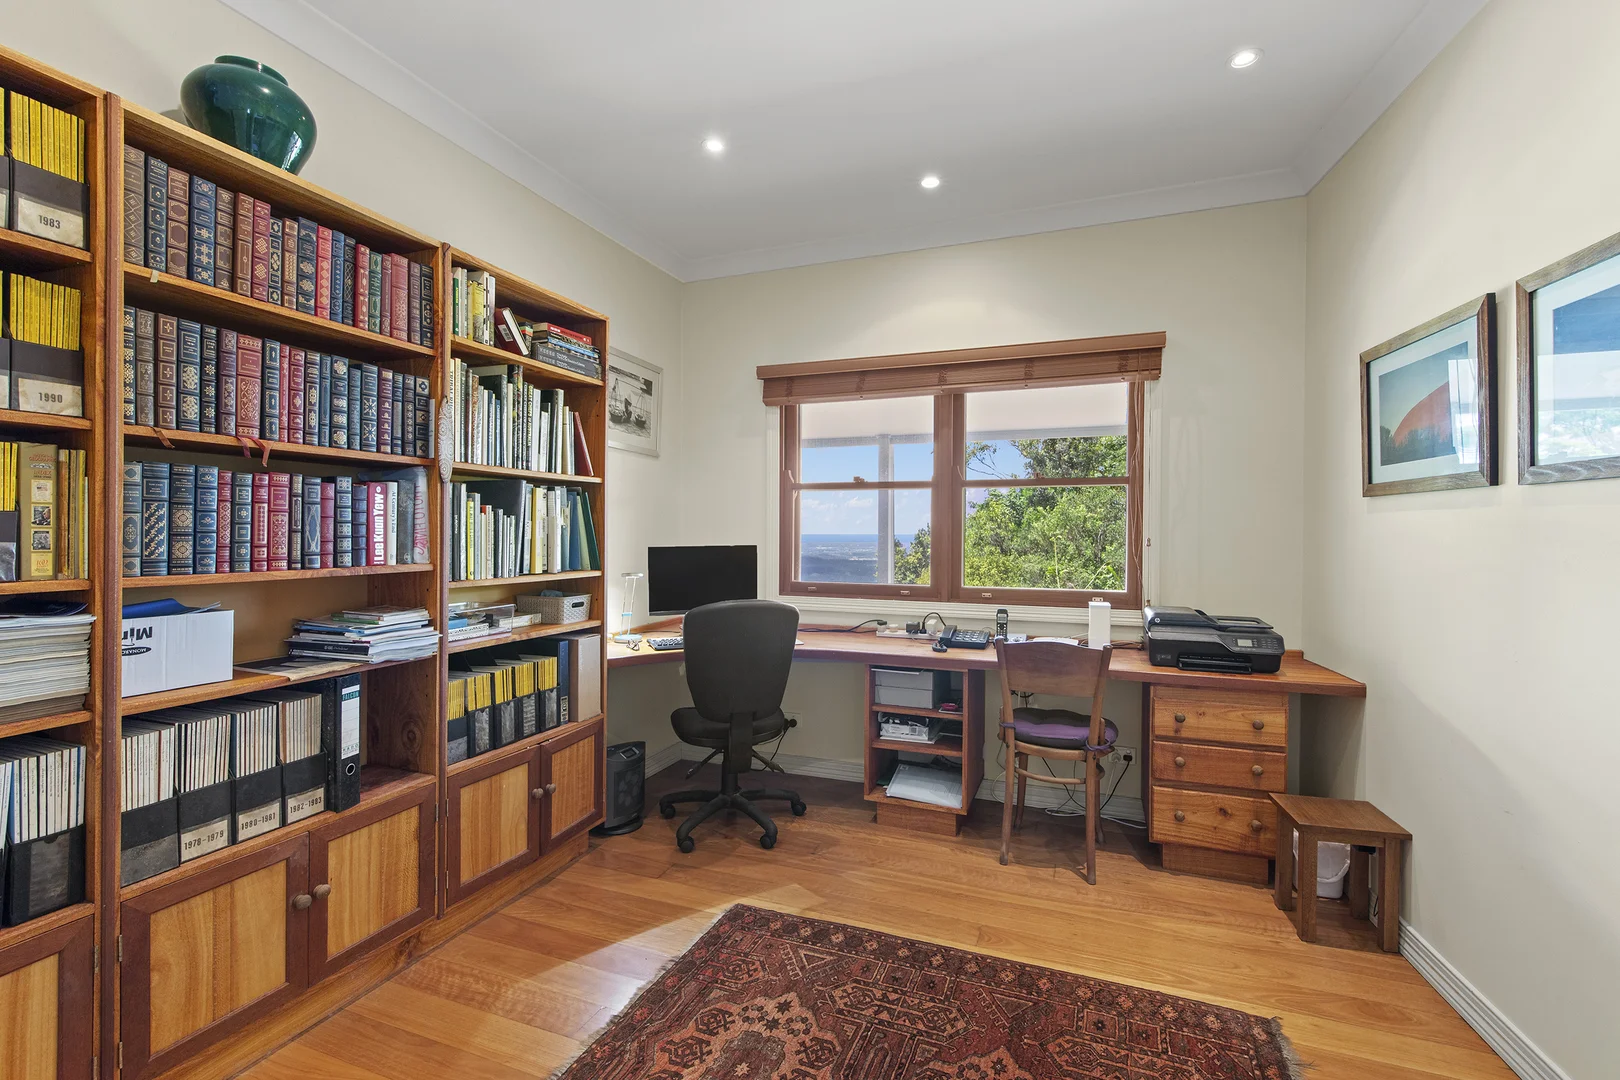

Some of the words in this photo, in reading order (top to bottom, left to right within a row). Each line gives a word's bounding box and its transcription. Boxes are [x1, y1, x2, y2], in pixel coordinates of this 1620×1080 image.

[38, 214, 61, 230] 1983
[38, 392, 63, 403] 1990
[372, 493, 384, 516] Yew
[373, 516, 384, 542] Kuan
[373, 542, 385, 561] Lee
[342, 690, 359, 701] FALCON
[289, 796, 322, 814] 1982-1983
[241, 812, 276, 830] 1980-1981
[184, 829, 224, 851] 1978-1979
